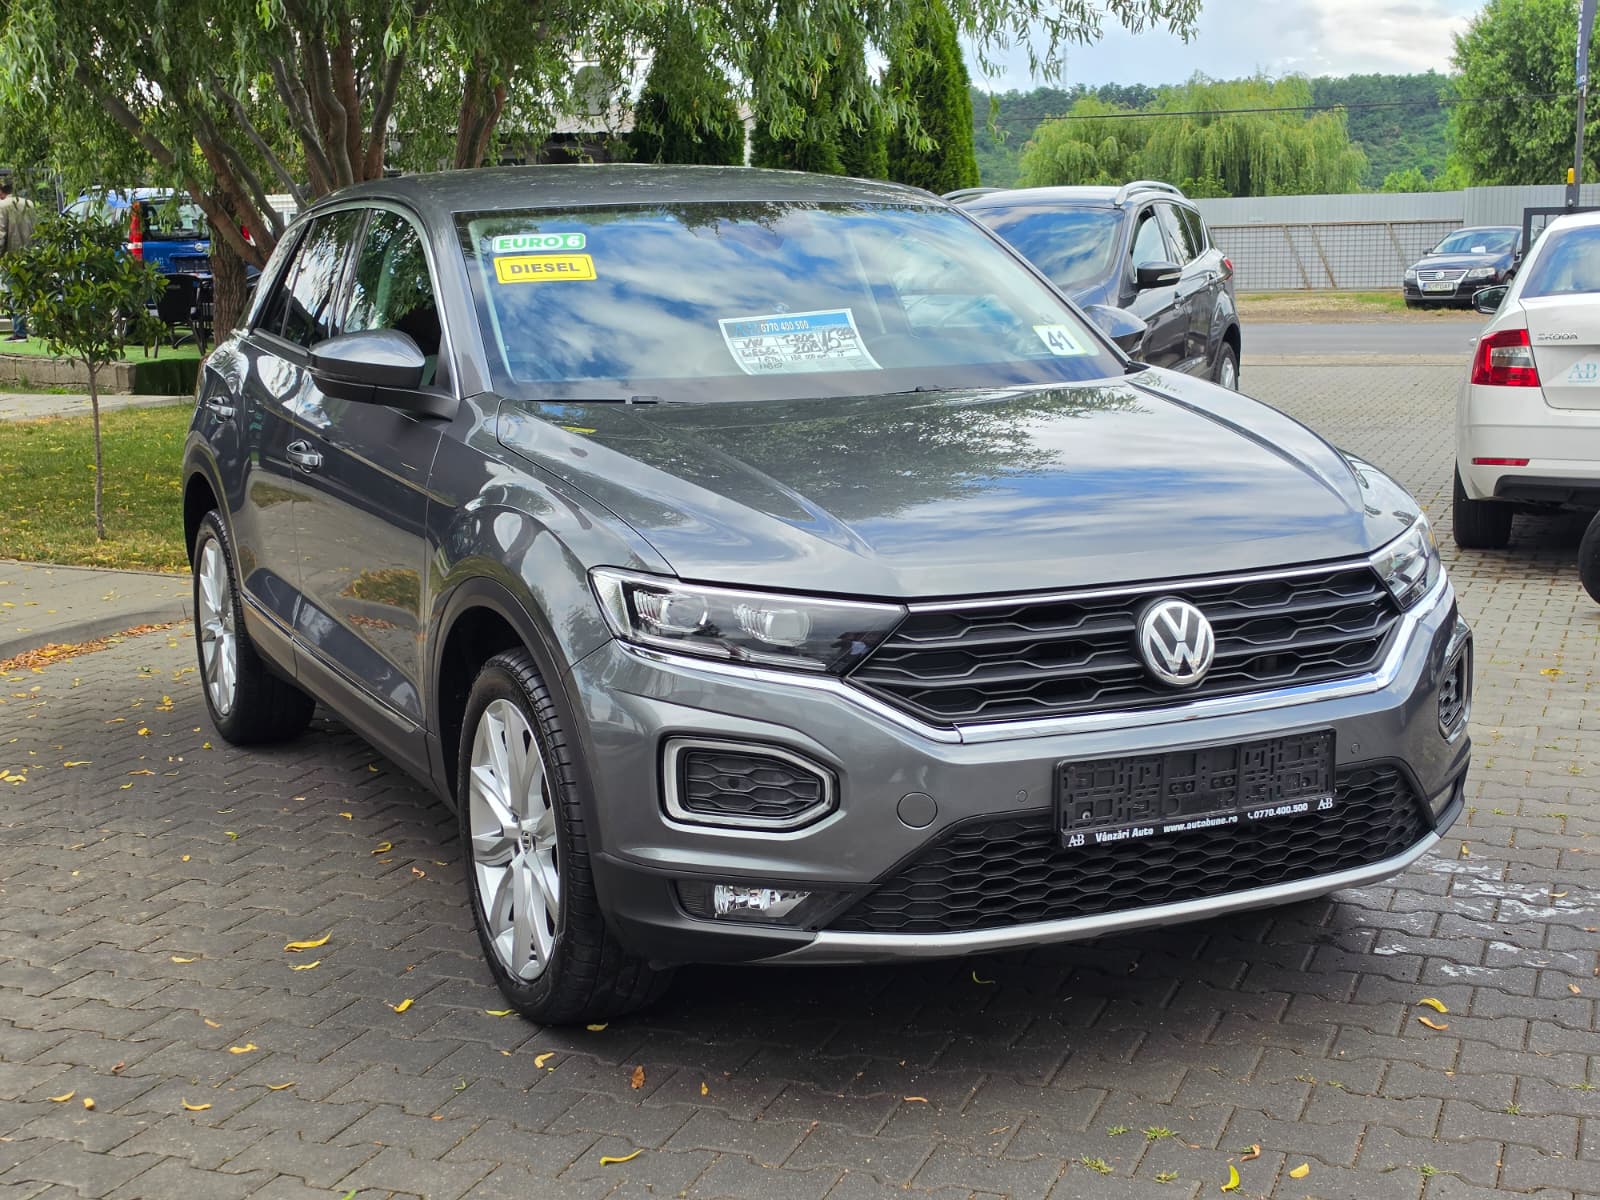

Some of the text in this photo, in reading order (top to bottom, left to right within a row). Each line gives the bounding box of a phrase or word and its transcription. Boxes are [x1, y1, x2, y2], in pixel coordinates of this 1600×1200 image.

[498, 235, 581, 250] EURO 6
[510, 262, 581, 275] DIESEL
[760, 320, 809, 333] 0770 400 500
[1047, 330, 1075, 350] 41
[1067, 834, 1085, 847] AB
[1132, 828, 1154, 838] Auto
[1163, 815, 1238, 833] www.autobune.ro
[1253, 802, 1309, 819] 0770.400.500
[1317, 797, 1333, 810] AB
